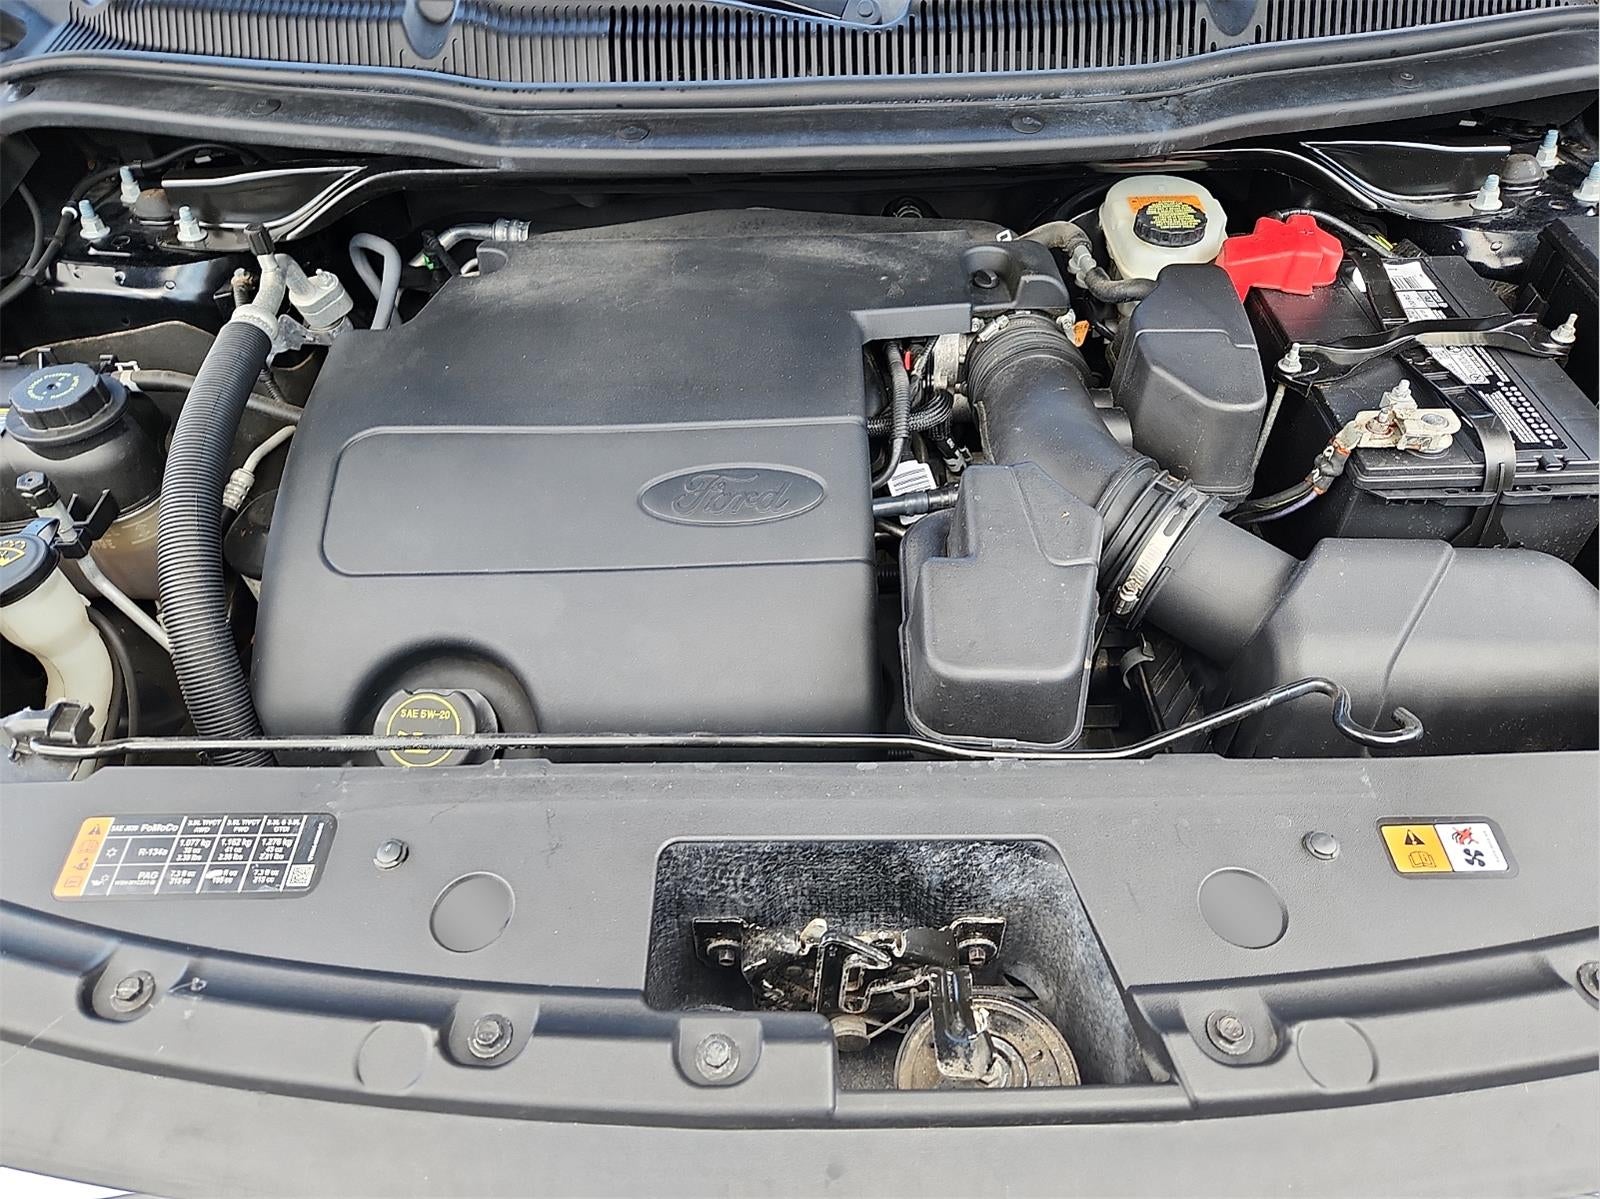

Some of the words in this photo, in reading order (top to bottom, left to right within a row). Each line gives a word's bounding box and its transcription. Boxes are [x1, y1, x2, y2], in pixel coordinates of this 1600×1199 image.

[672, 472, 793, 516] Ford
[400, 708, 419, 719] SAE
[420, 709, 451, 720] 5W-20
[140, 824, 179, 832] FoMoCo
[180, 839, 200, 847] 1.077
[200, 839, 212, 848] kg
[242, 839, 253, 848] kg
[283, 838, 293, 848] kg
[138, 848, 168, 857] R-134a
[138, 871, 159, 880] PAG
